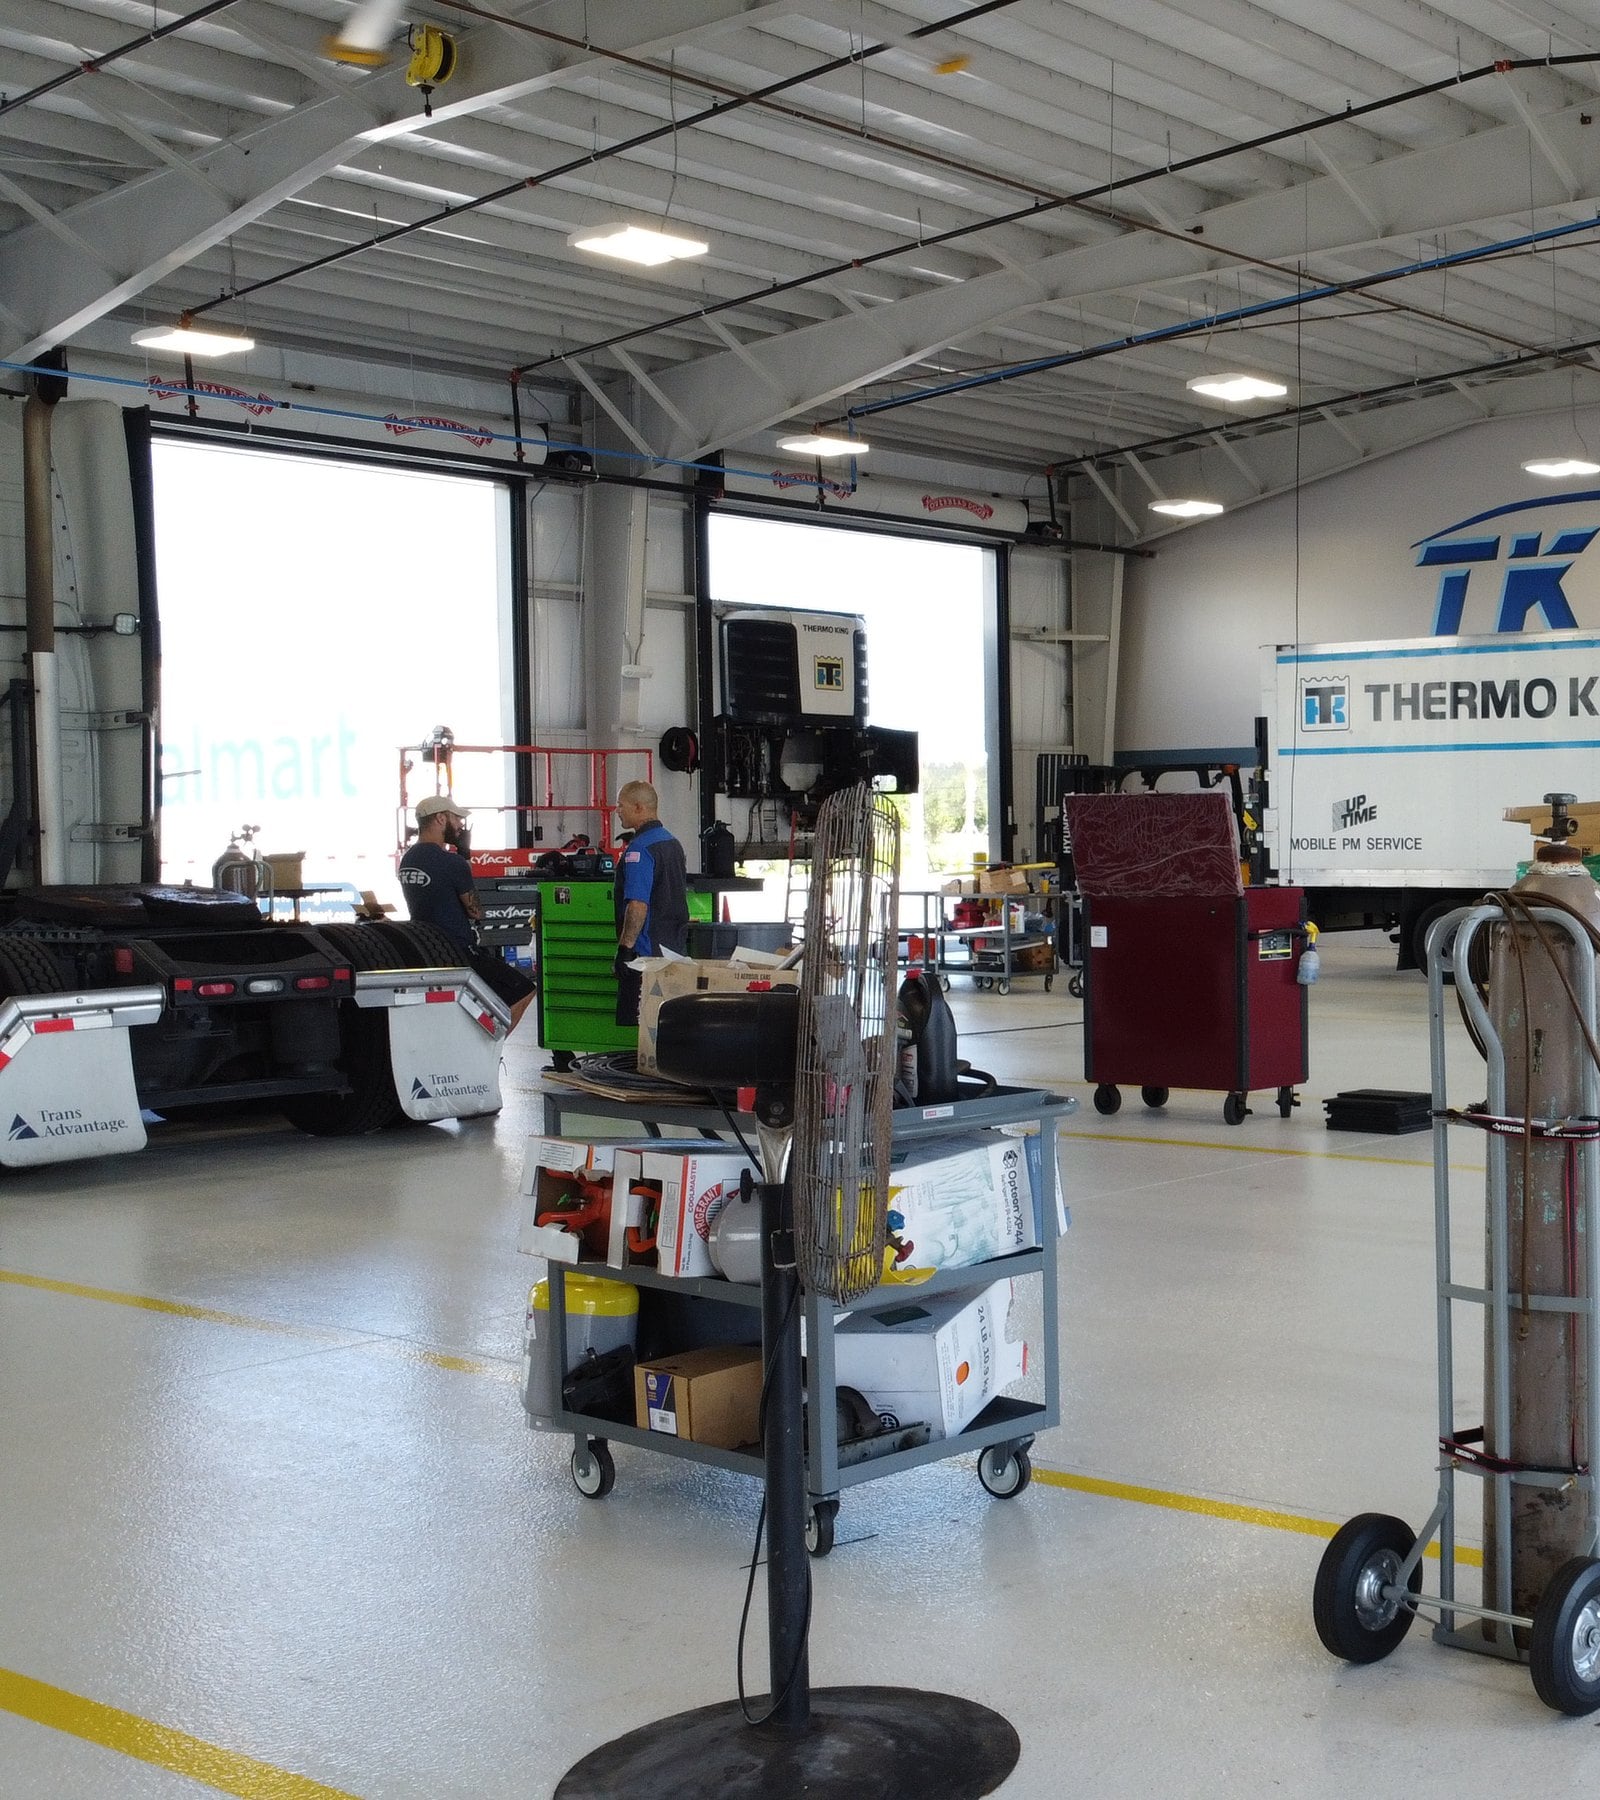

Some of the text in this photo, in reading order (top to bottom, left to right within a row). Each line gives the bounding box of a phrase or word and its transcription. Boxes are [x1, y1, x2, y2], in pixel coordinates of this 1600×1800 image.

[802, 624, 849, 635] THERMO KING
[1364, 677, 1558, 722] THERMO
[162, 714, 358, 806] almart
[1345, 794, 1367, 815] UP
[1341, 804, 1378, 829] TIME
[1290, 836, 1422, 851] MOBILE PM SERVICE
[470, 853, 513, 865] KYJACK
[430, 1073, 460, 1085] Trans
[40, 1108, 82, 1122] Trans
[687, 1159, 697, 1213] COOLMASTER
[1014, 1214, 1024, 1245] XP44
[977, 1305, 986, 1323] 24
[980, 1326, 988, 1342] LB
